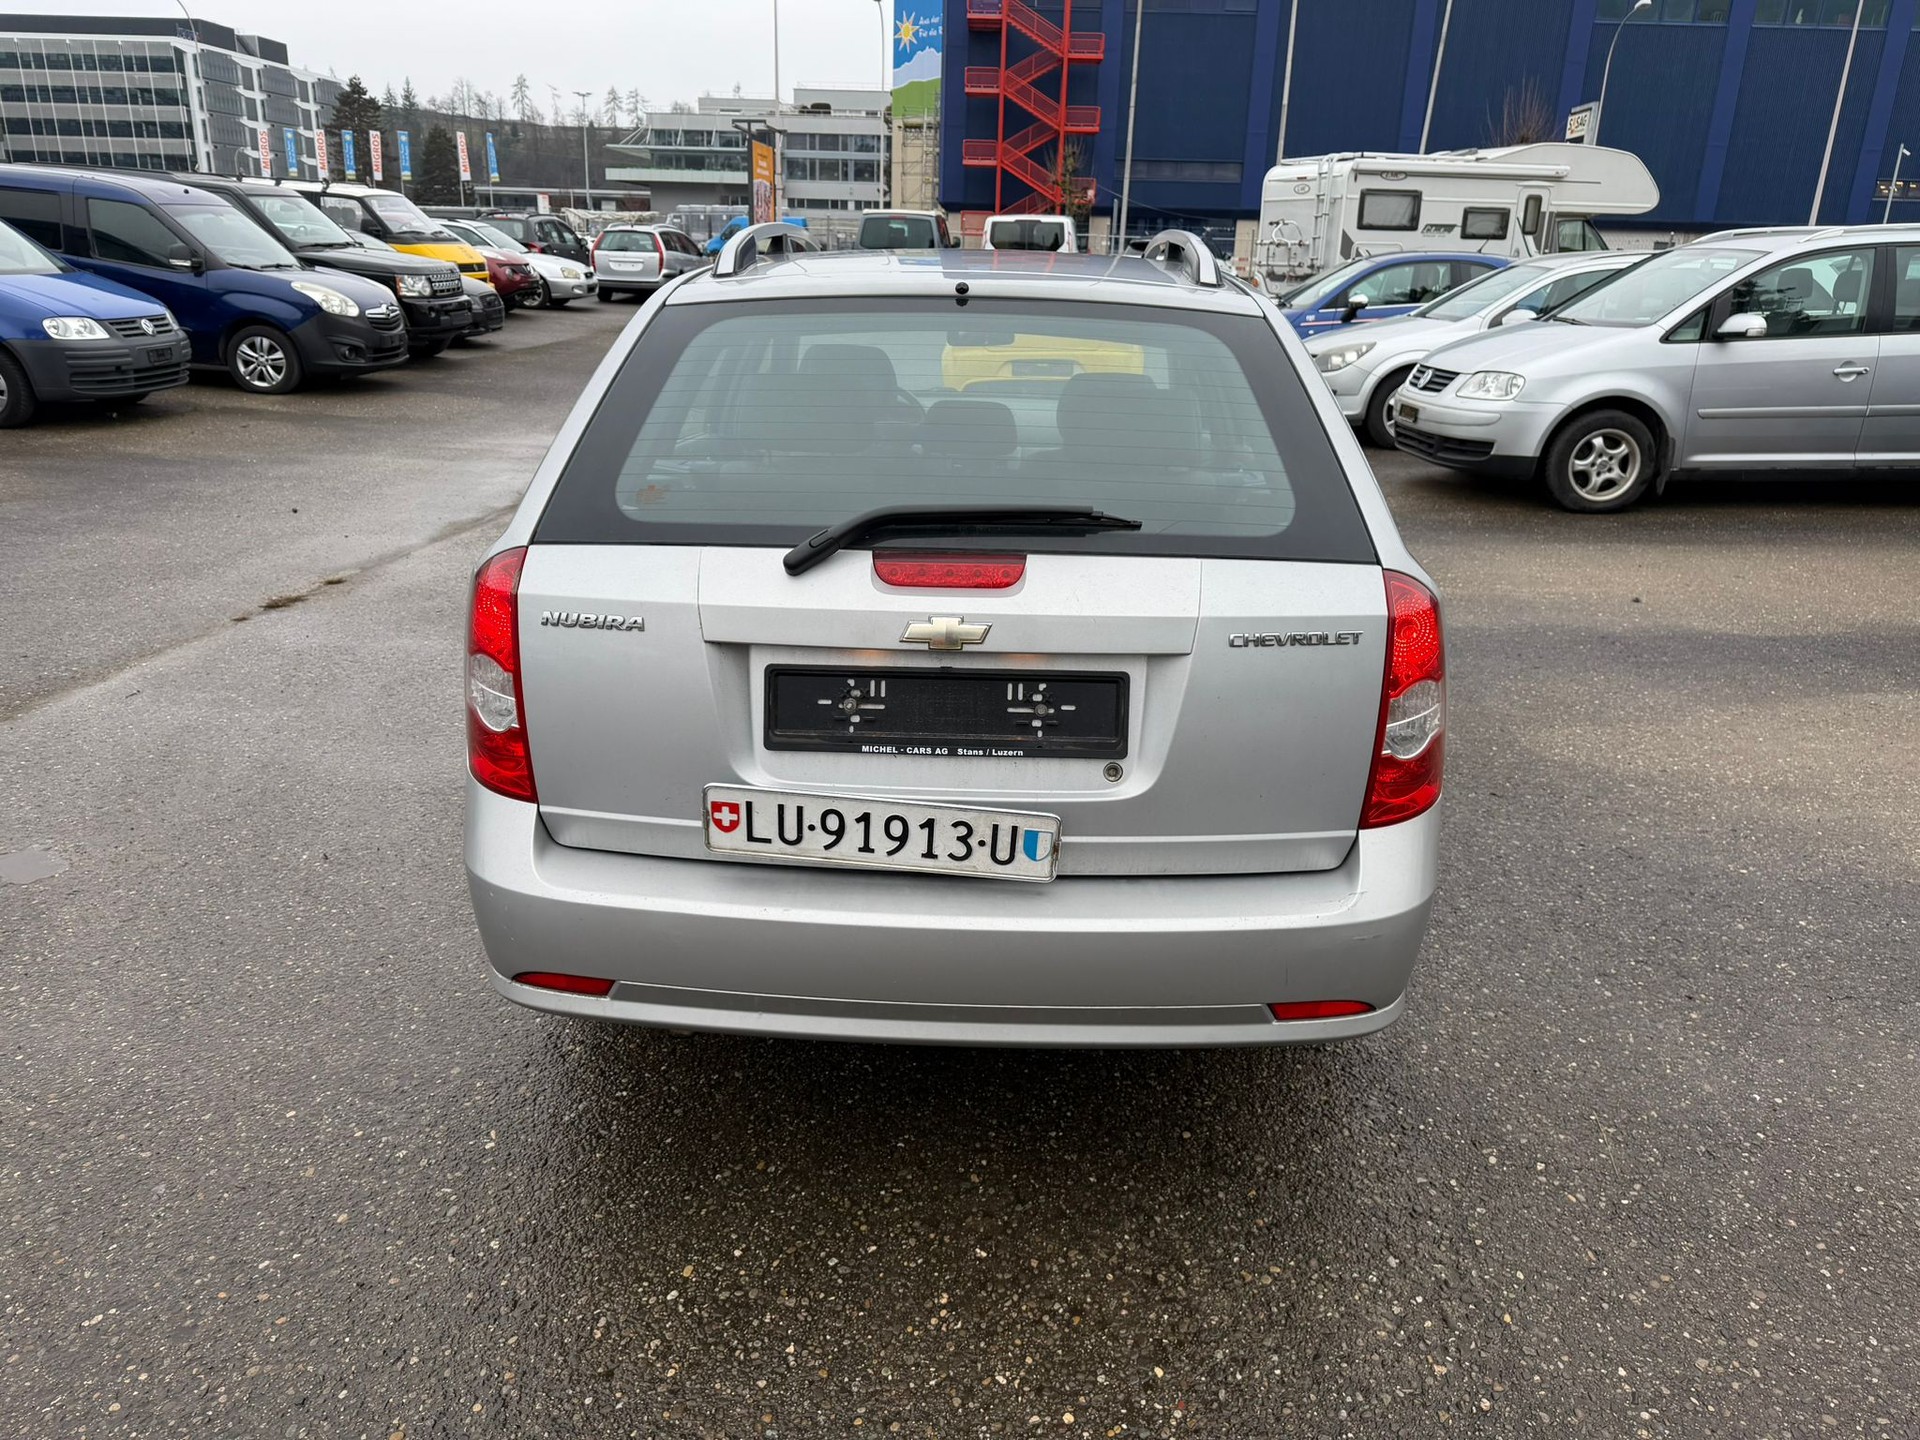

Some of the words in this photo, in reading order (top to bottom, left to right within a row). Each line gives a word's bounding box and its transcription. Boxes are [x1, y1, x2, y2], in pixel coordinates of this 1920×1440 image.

[260, 130, 271, 170] MIGROS
[316, 131, 327, 171] MIGROS
[372, 133, 381, 173] MIGROS
[459, 133, 469, 173] MIGROS
[541, 610, 645, 632] NUBIRA
[1228, 630, 1364, 648] CHEVROLET
[861, 745, 898, 754] MICHEL
[906, 746, 932, 755] CARS
[935, 747, 949, 755] AG
[957, 748, 984, 756] Stans
[992, 748, 1024, 756] Luzern
